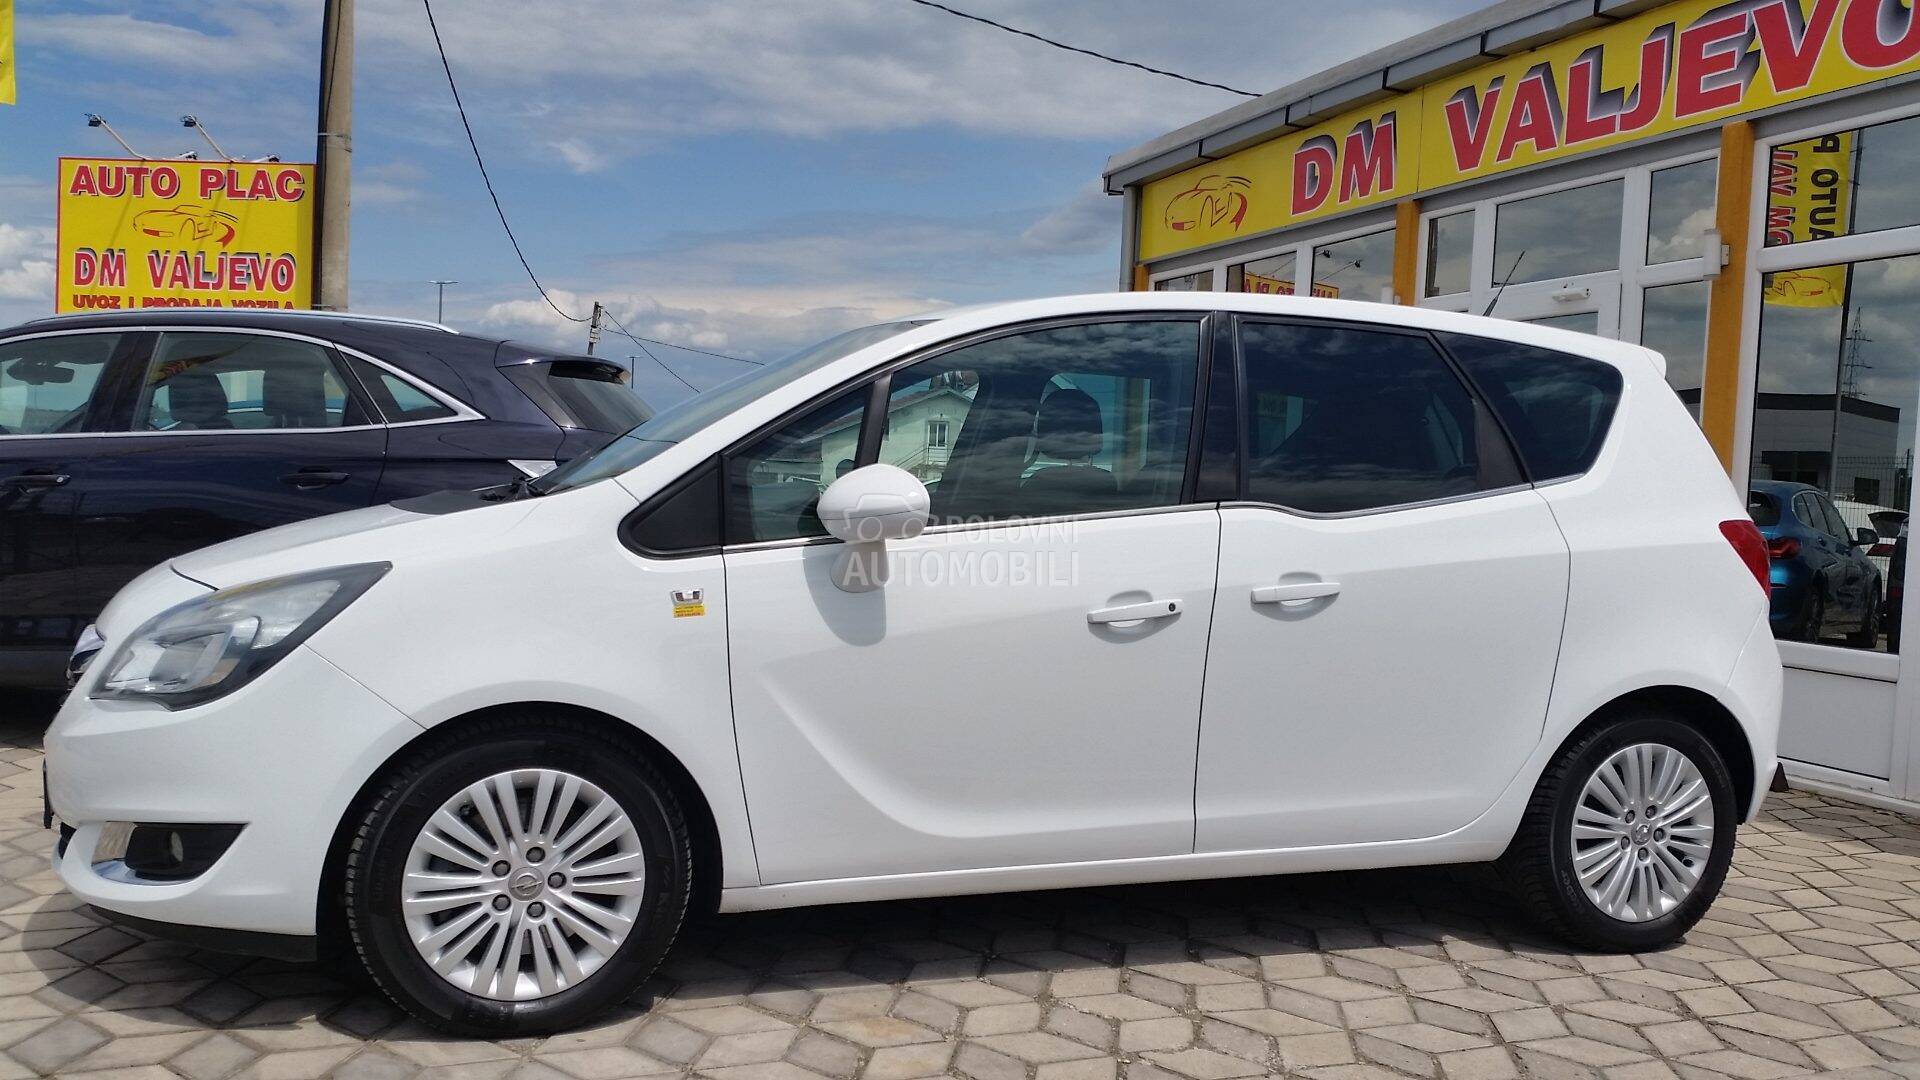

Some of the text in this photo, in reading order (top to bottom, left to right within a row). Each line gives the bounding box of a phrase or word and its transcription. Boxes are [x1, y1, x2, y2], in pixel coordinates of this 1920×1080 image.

[69, 165, 304, 202] AUTO PLAC
[1291, 111, 1398, 216] DM
[73, 248, 297, 293] DM VALJEVO
[73, 294, 120, 309] UVOZ
